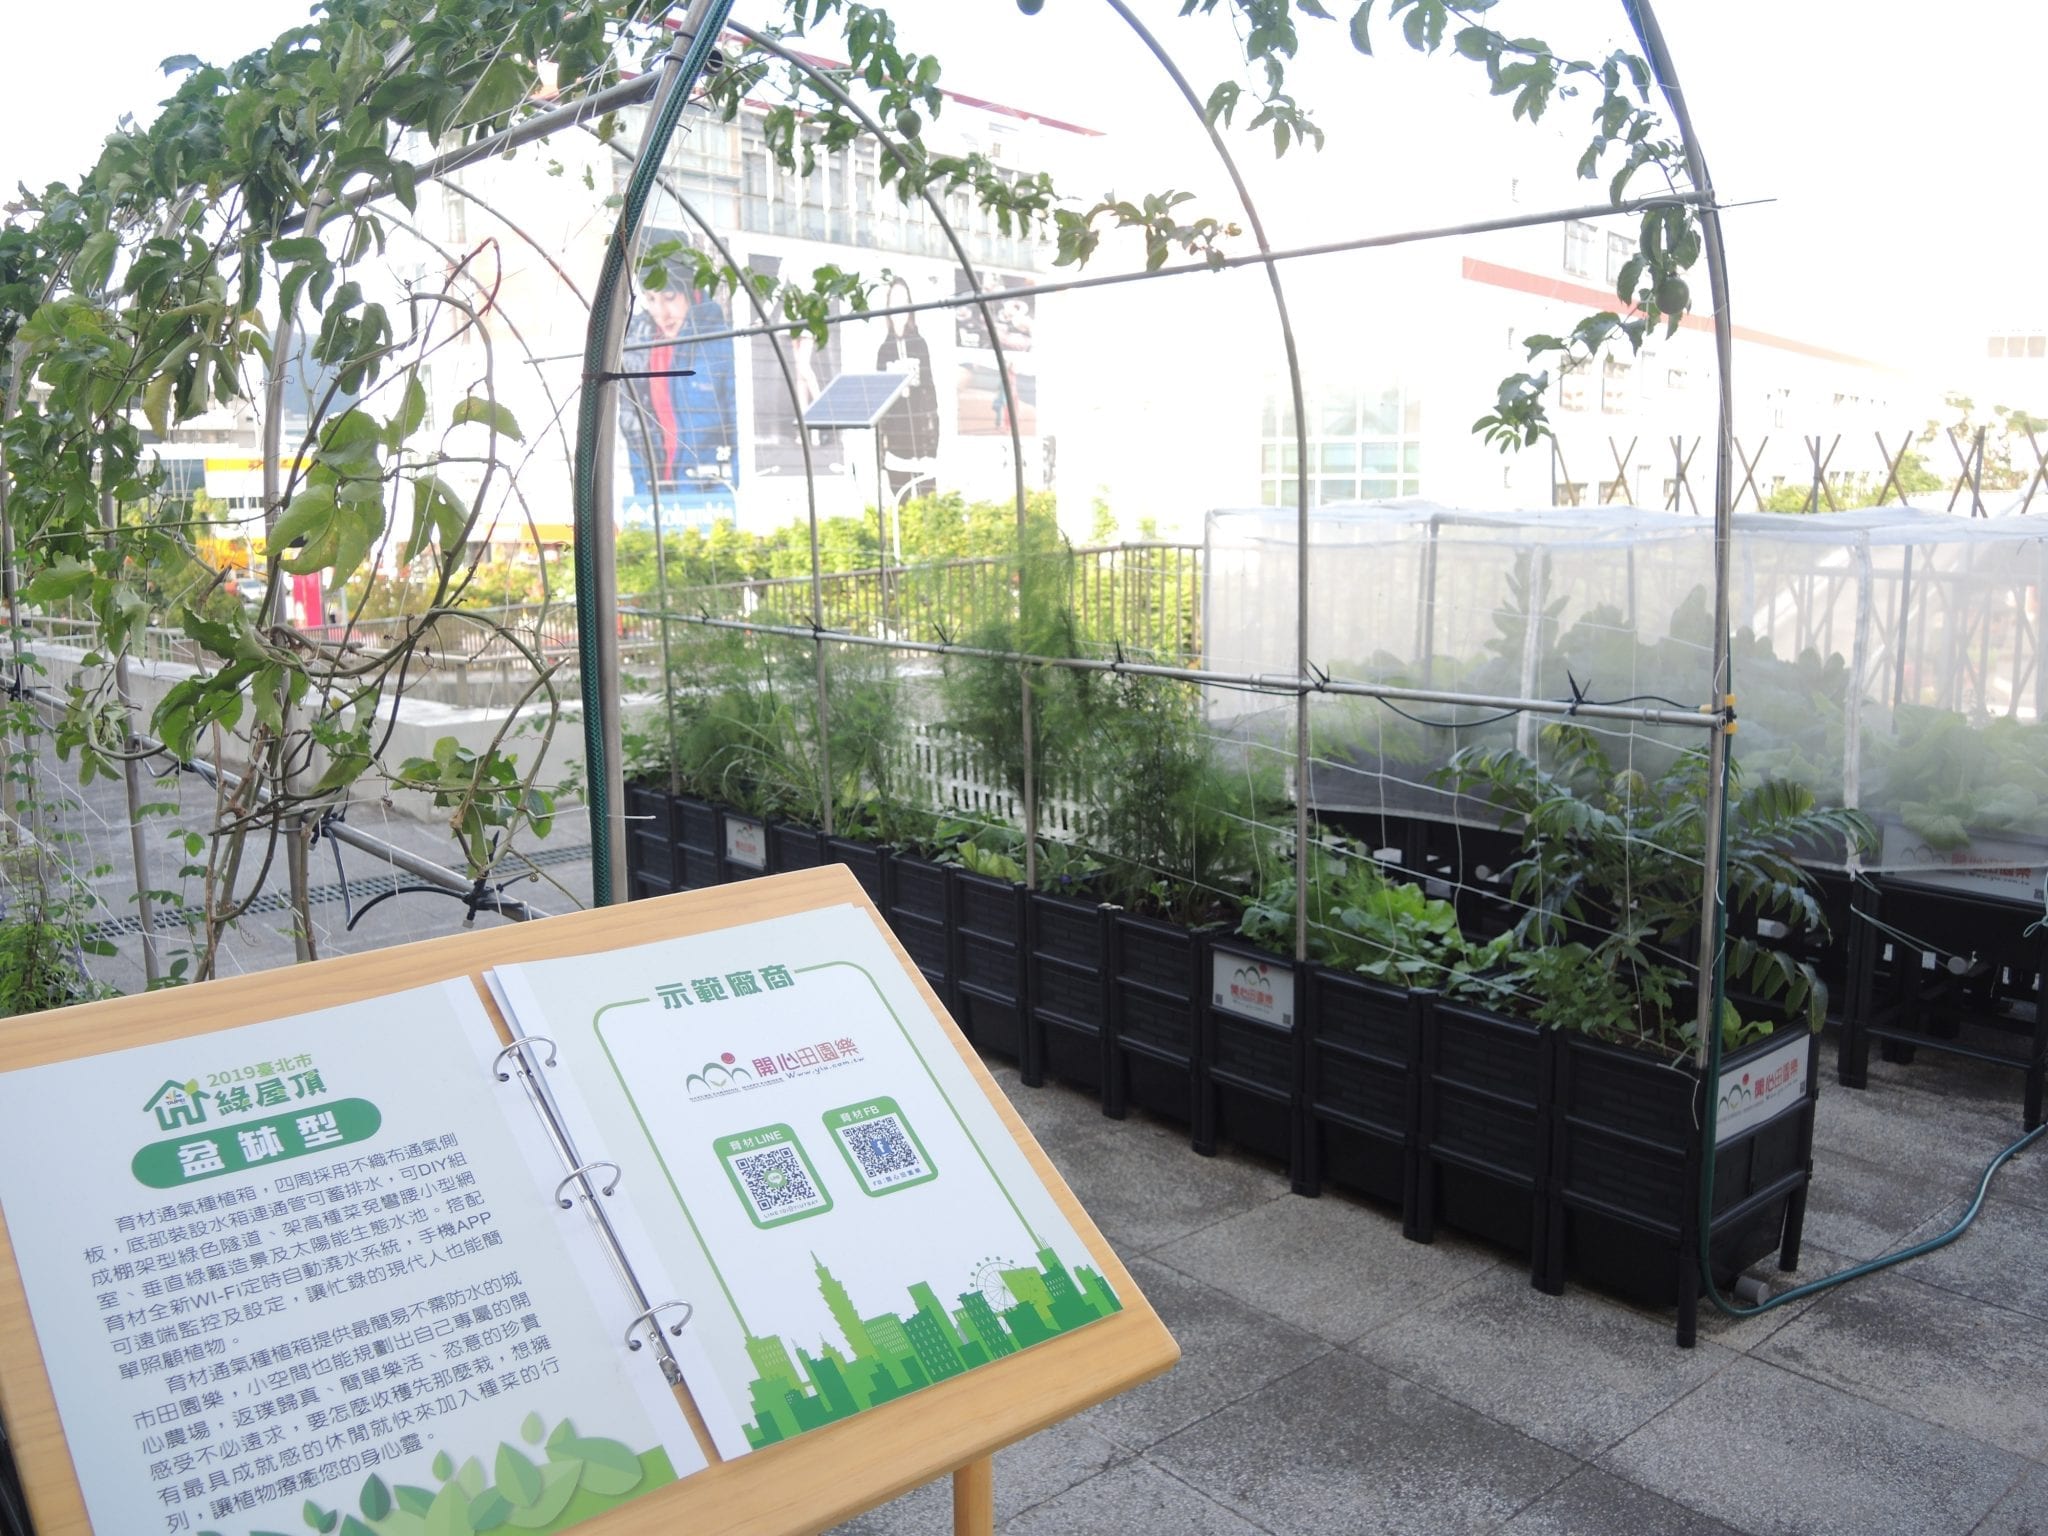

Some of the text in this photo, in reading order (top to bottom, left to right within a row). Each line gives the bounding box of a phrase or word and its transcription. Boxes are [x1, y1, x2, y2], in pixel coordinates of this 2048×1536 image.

[655, 964, 795, 1010] 示範廠商
[206, 1053, 314, 1087] 2019臺北市
[752, 1037, 859, 1077] 開心田園樂
[215, 1068, 327, 1116] 綠屋頂
[177, 1110, 343, 1178] 盆缽型
[118, 1337, 240, 1381] 單照顧植物。
